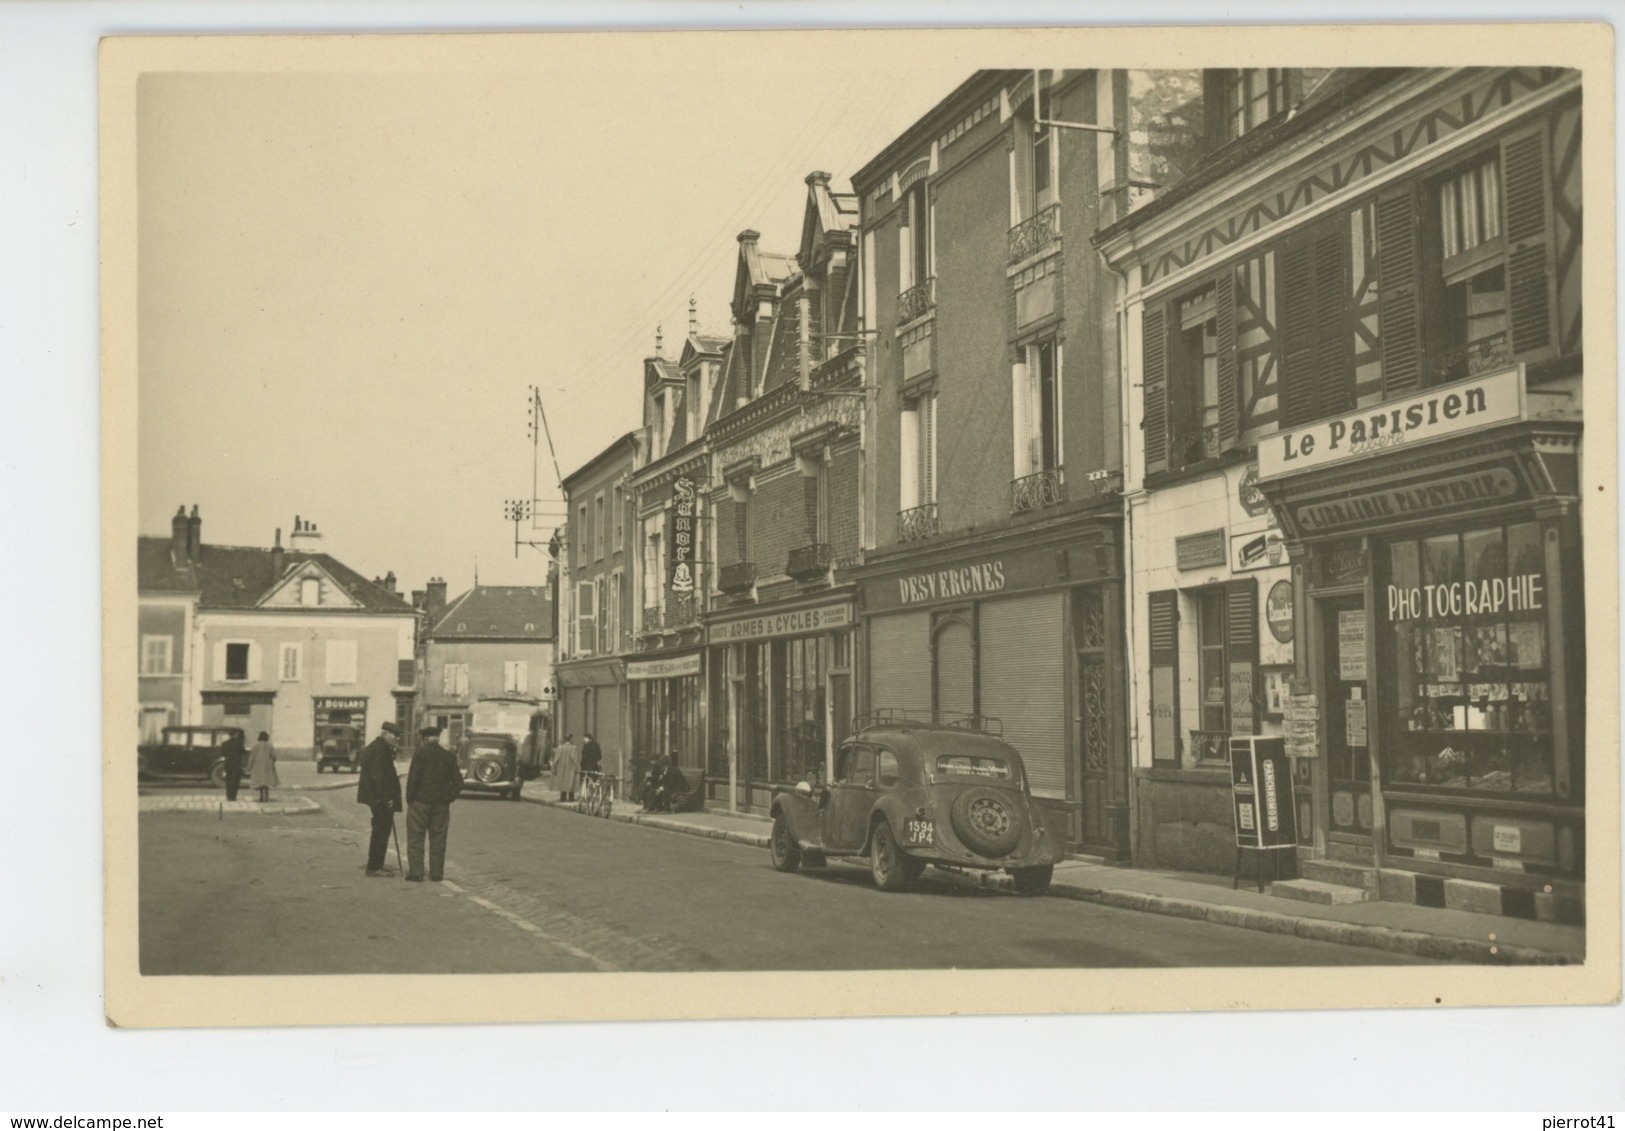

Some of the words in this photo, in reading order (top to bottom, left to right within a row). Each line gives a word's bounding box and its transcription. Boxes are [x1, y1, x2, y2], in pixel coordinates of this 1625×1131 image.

[1283, 433, 1315, 461] Le
[1329, 387, 1487, 450] Parisien
[1308, 494, 1394, 528] LIBRAIRIE
[1393, 474, 1500, 512] PAPETERIE
[898, 561, 1006, 603] DESVERGNES
[1387, 573, 1543, 621] PHOTOGRAPHIE
[730, 619, 763, 638] ARMES
[776, 611, 820, 632] CYCLES
[1231, 671, 1251, 684] PHOTO
[325, 699, 365, 709] BOULARD
[1264, 760, 1278, 830] PANCHROMOSA
[908, 820, 934, 833] 1594
[909, 831, 934, 844] JP4
